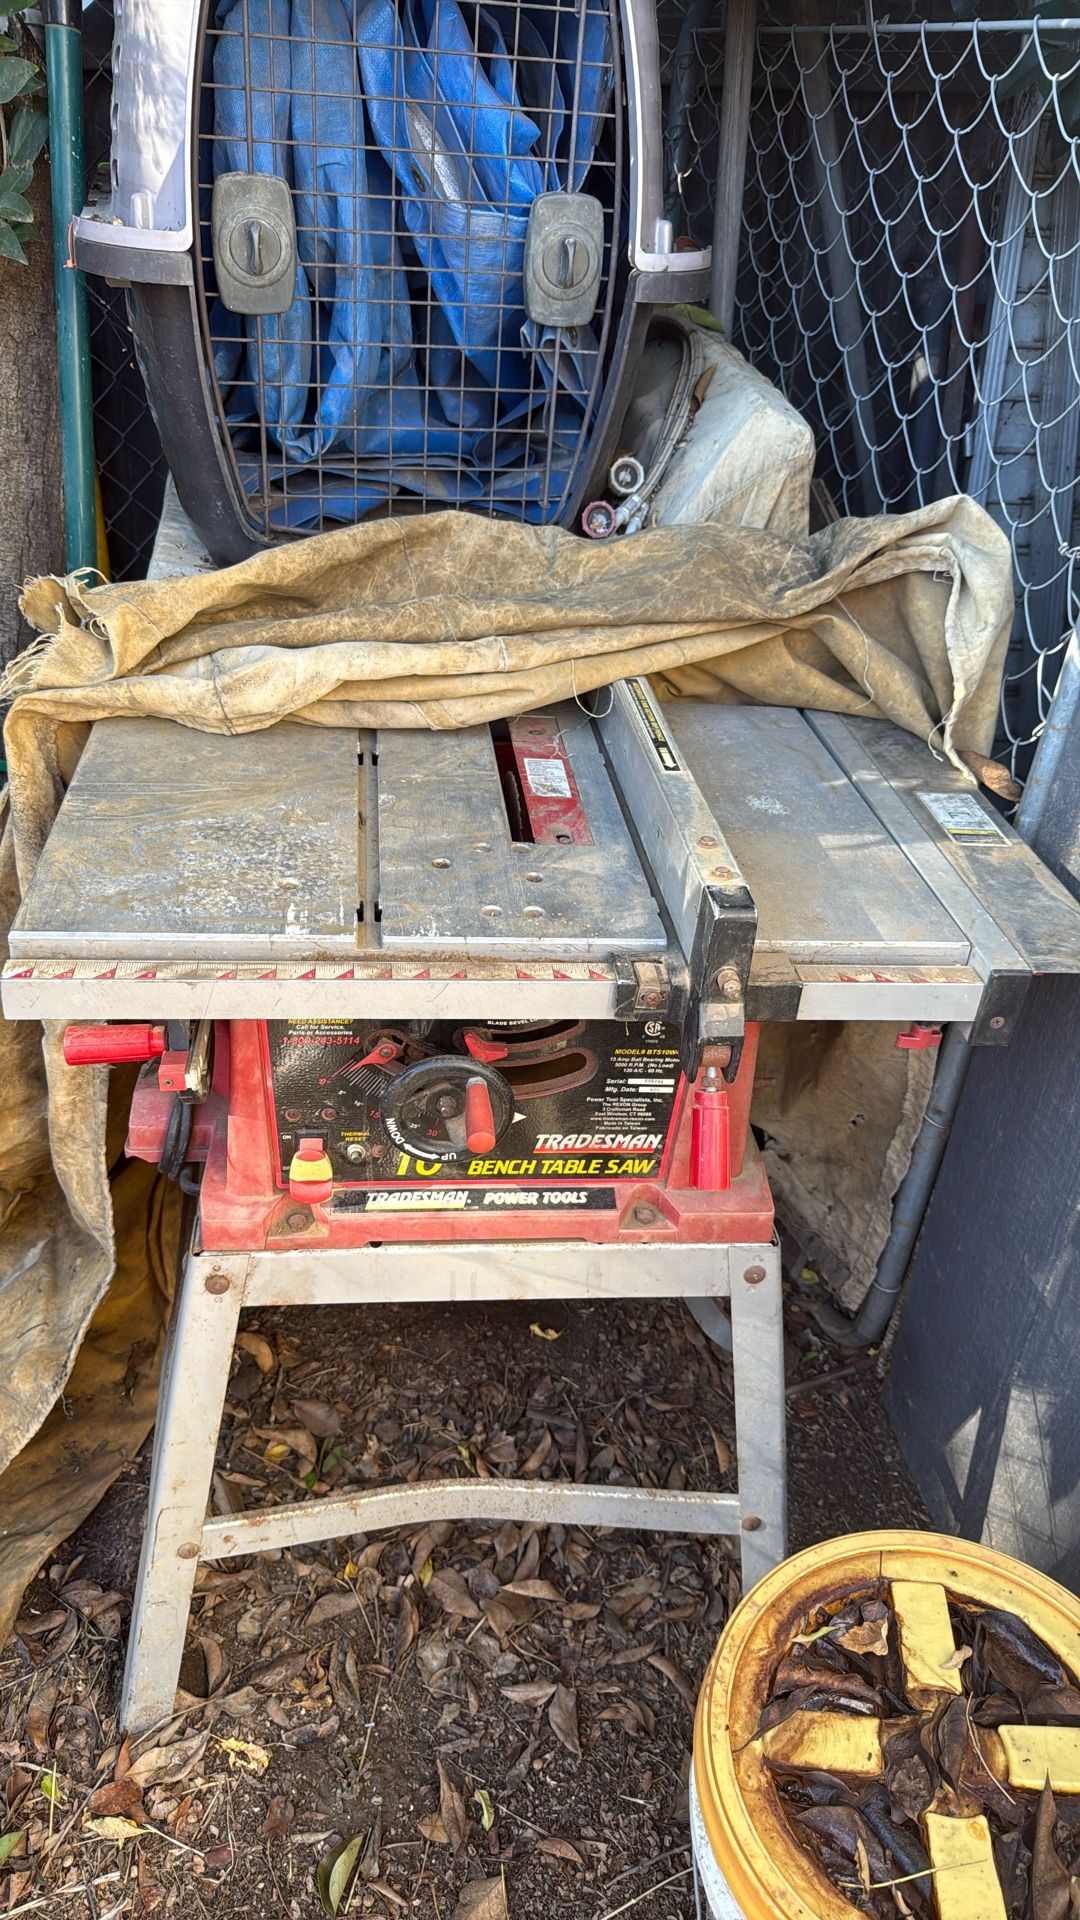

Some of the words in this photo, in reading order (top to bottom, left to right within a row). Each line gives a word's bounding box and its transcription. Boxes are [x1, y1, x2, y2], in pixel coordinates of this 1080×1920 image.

[282, 1036, 360, 1045] 1-800-243-5114
[385, 1117, 406, 1145] DOWN
[535, 1133, 663, 1151] TRADESMAN
[441, 1152, 457, 1161] UP
[467, 1160, 538, 1175] BENCH
[541, 1159, 603, 1174] TABLE
[605, 1159, 656, 1174] SAW
[366, 1191, 469, 1204] TRADESMAN
[483, 1191, 540, 1205] POWER
[543, 1191, 588, 1204] TOOLS
